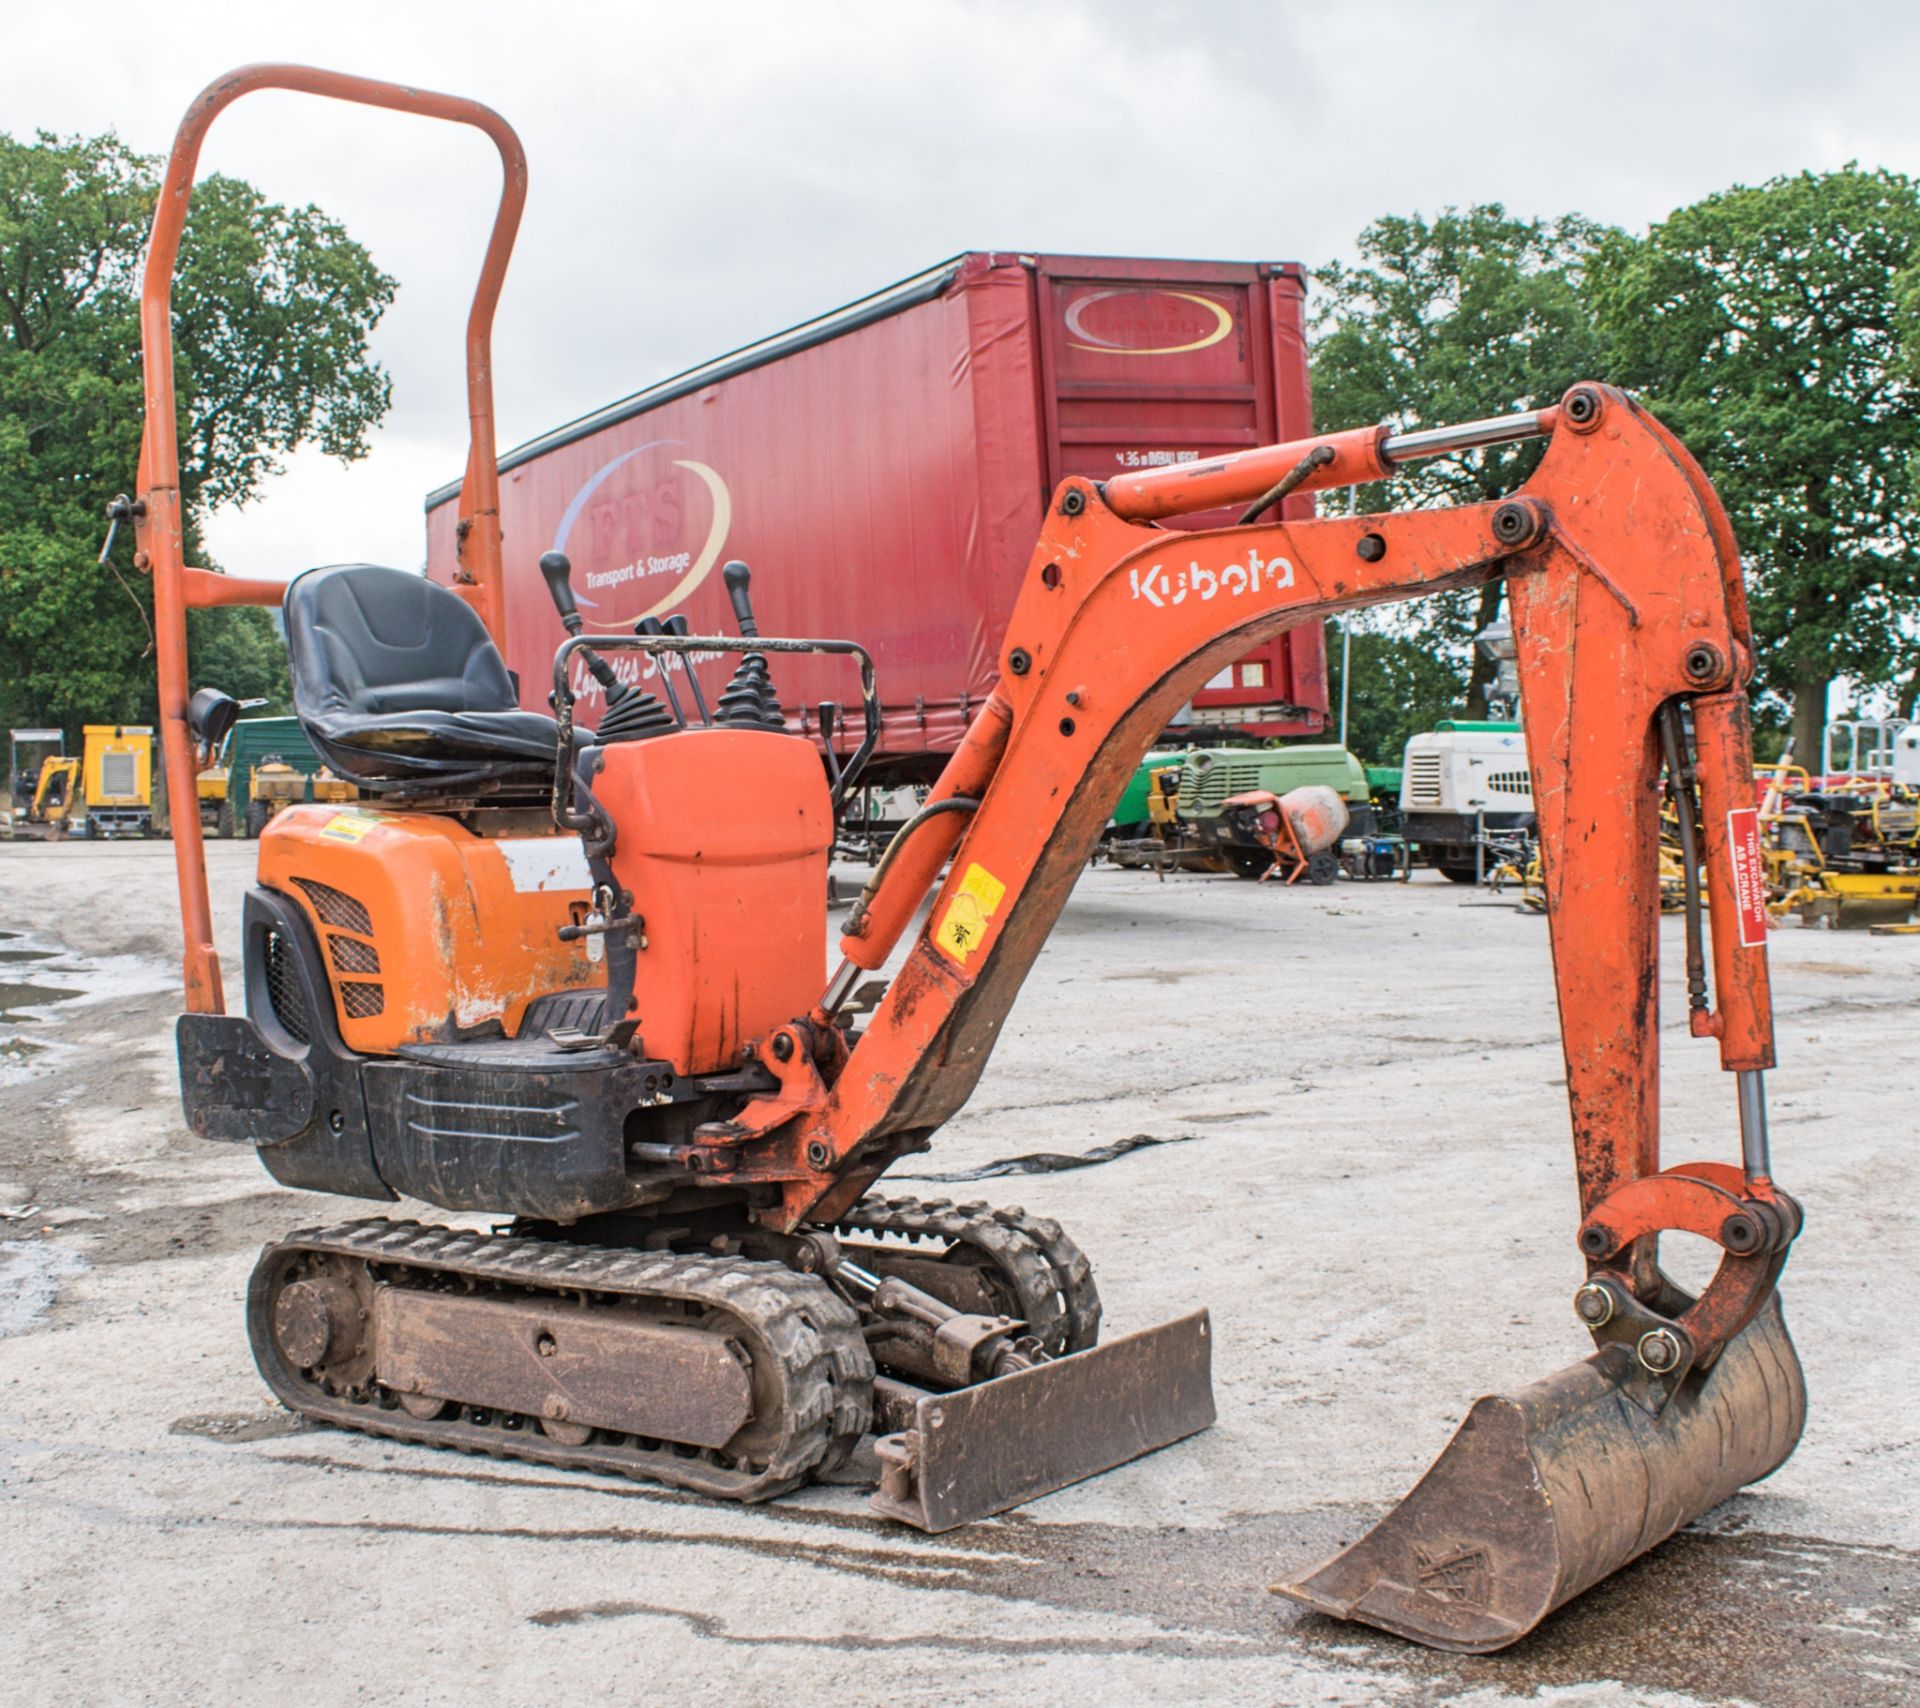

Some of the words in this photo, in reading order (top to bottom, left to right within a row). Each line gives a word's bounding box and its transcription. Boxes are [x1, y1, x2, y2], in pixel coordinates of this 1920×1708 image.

[1115, 451, 1140, 467] 4.36
[586, 563, 634, 590] Transport
[636, 559, 645, 577] &
[647, 552, 690, 574] Storage
[1129, 549, 1295, 608] Kubota
[1736, 845, 1747, 861] AS
[1746, 831, 1756, 856] THIS
[1738, 862, 1747, 871] A
[1740, 873, 1752, 911] CRANE
[1749, 857, 1763, 922] EXCAVATOR
